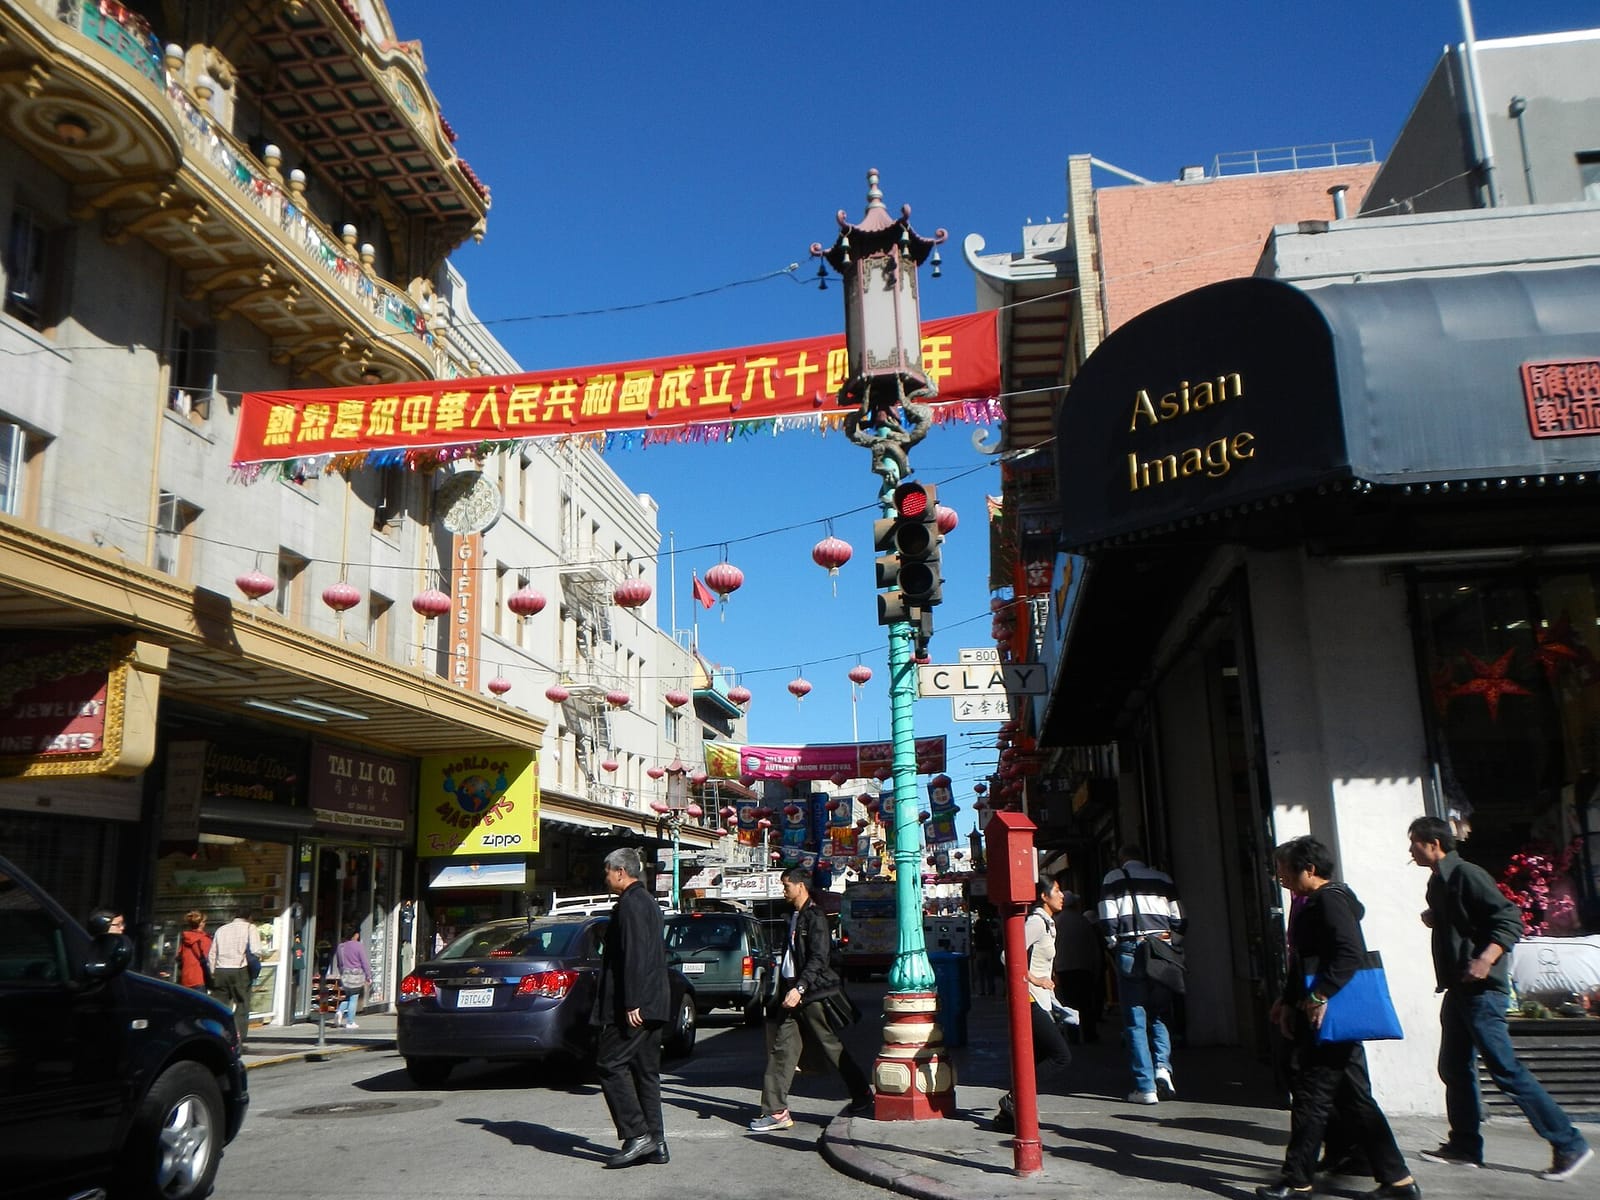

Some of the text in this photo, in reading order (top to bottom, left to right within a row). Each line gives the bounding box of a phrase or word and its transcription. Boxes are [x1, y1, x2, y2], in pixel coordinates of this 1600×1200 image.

[263, 335, 953, 447] 熱烈慶祝中華人民共和國成立六十四年
[1129, 371, 1243, 433] Asian
[1127, 432, 1255, 492] Image
[457, 544, 472, 625] GIFTS
[975, 650, 997, 661] 800
[933, 669, 1034, 690] CLAY
[0, 732, 96, 750] INE ARTS
[328, 754, 397, 786] TAI LI CO.
[442, 756, 509, 776] WORLD OF
[435, 795, 515, 828] MAGNETS
[482, 834, 522, 848] zippo
